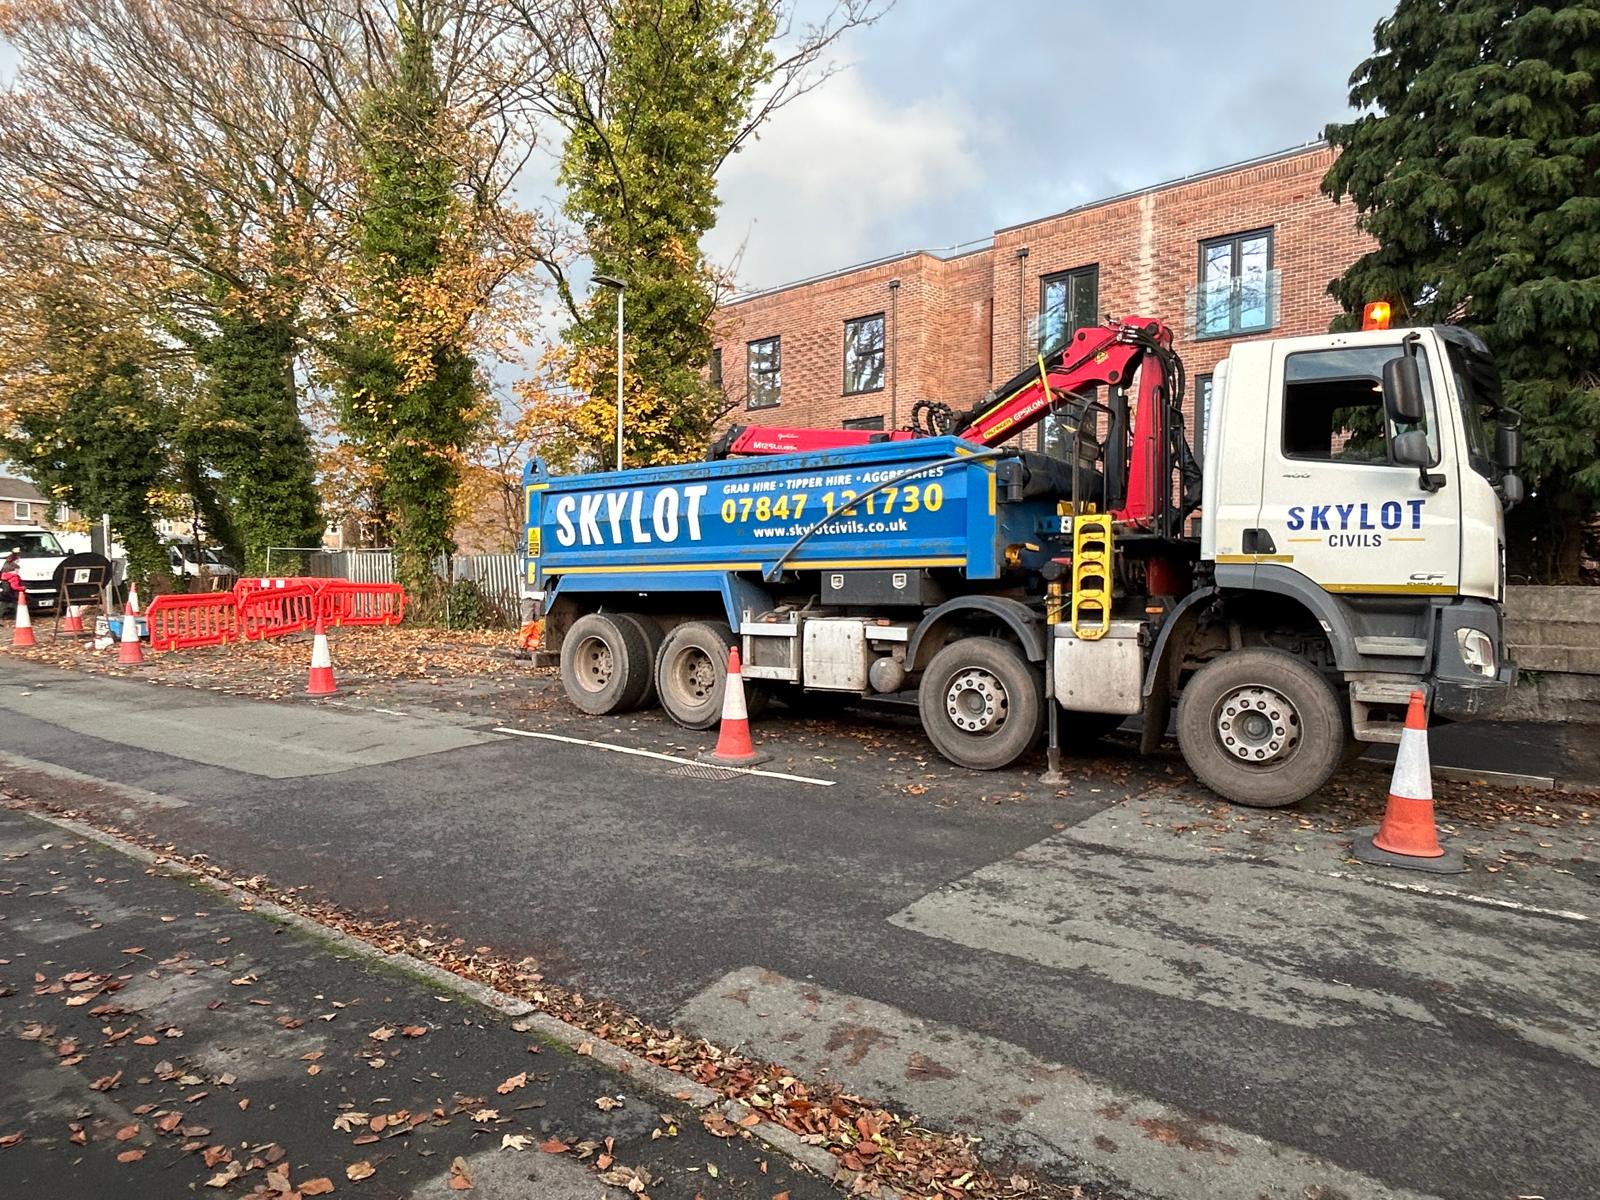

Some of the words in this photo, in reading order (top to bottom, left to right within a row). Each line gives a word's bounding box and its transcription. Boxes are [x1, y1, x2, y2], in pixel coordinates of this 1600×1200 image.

[1013, 398, 1045, 421] EPSILON
[723, 484, 750, 495] GRAB
[752, 481, 777, 493] HIRE
[786, 477, 823, 489] TIPPER
[825, 474, 852, 486] HIRE
[556, 485, 708, 547] SKYLOT
[720, 493, 808, 524] 07847
[822, 483, 944, 518] 121730
[1286, 499, 1426, 531] SKYLOT
[1328, 534, 1383, 547] CIVILS
